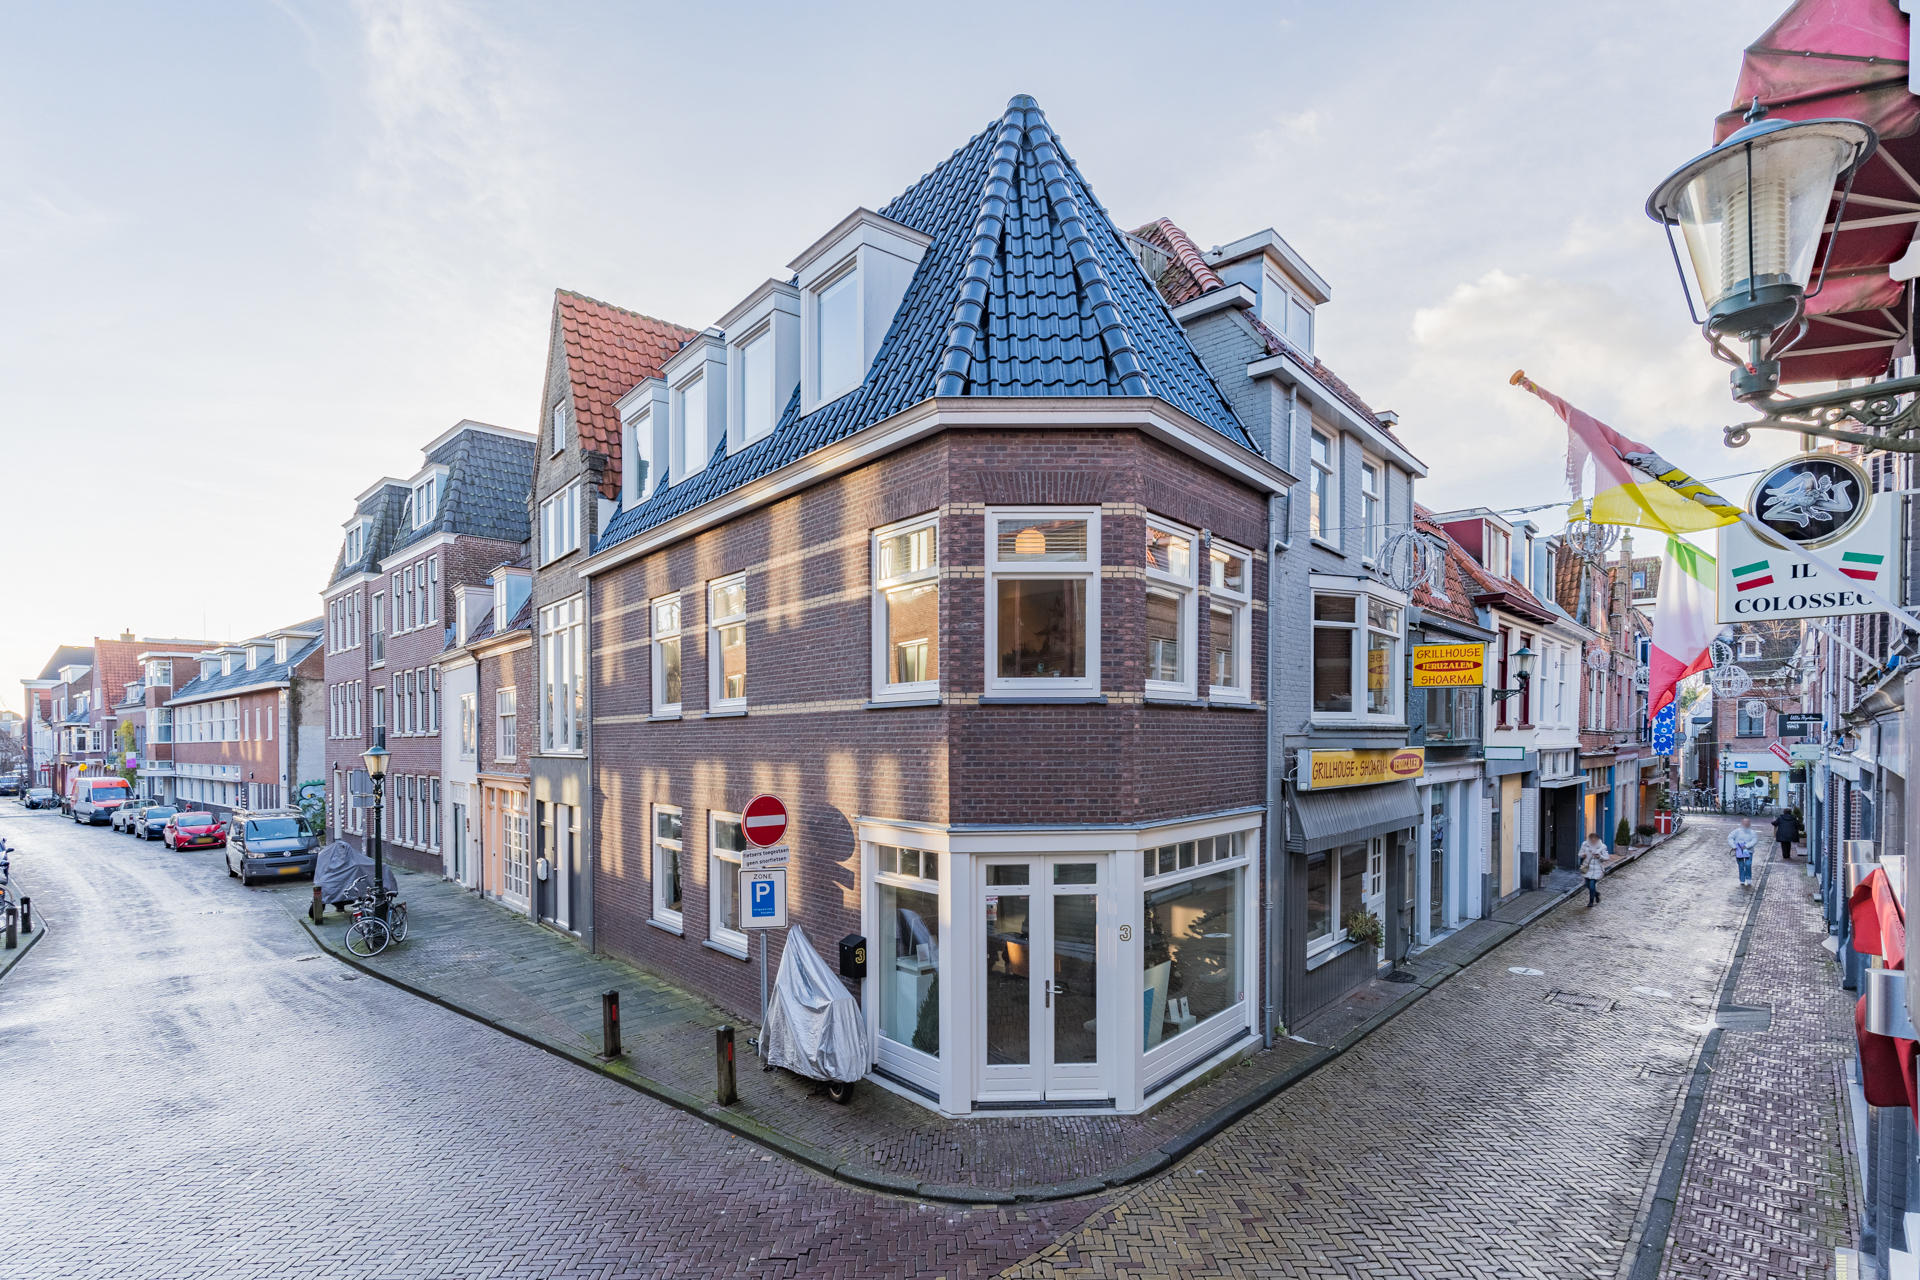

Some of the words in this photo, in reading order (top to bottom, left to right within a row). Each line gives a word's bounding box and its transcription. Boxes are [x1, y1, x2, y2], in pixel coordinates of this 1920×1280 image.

[1790, 563, 1818, 579] IL
[1416, 647, 1481, 659] GRILLHOUSE
[1421, 661, 1474, 670] JERUZALEM
[1421, 674, 1475, 685] SHOARMA
[1312, 760, 1355, 780] GRILLHOUSE
[1359, 758, 1388, 777] SHOARMA
[763, 848, 789, 856] toegestaan
[756, 883, 770, 903] P
[1119, 924, 1131, 941] 3
[855, 947, 865, 964] 3
